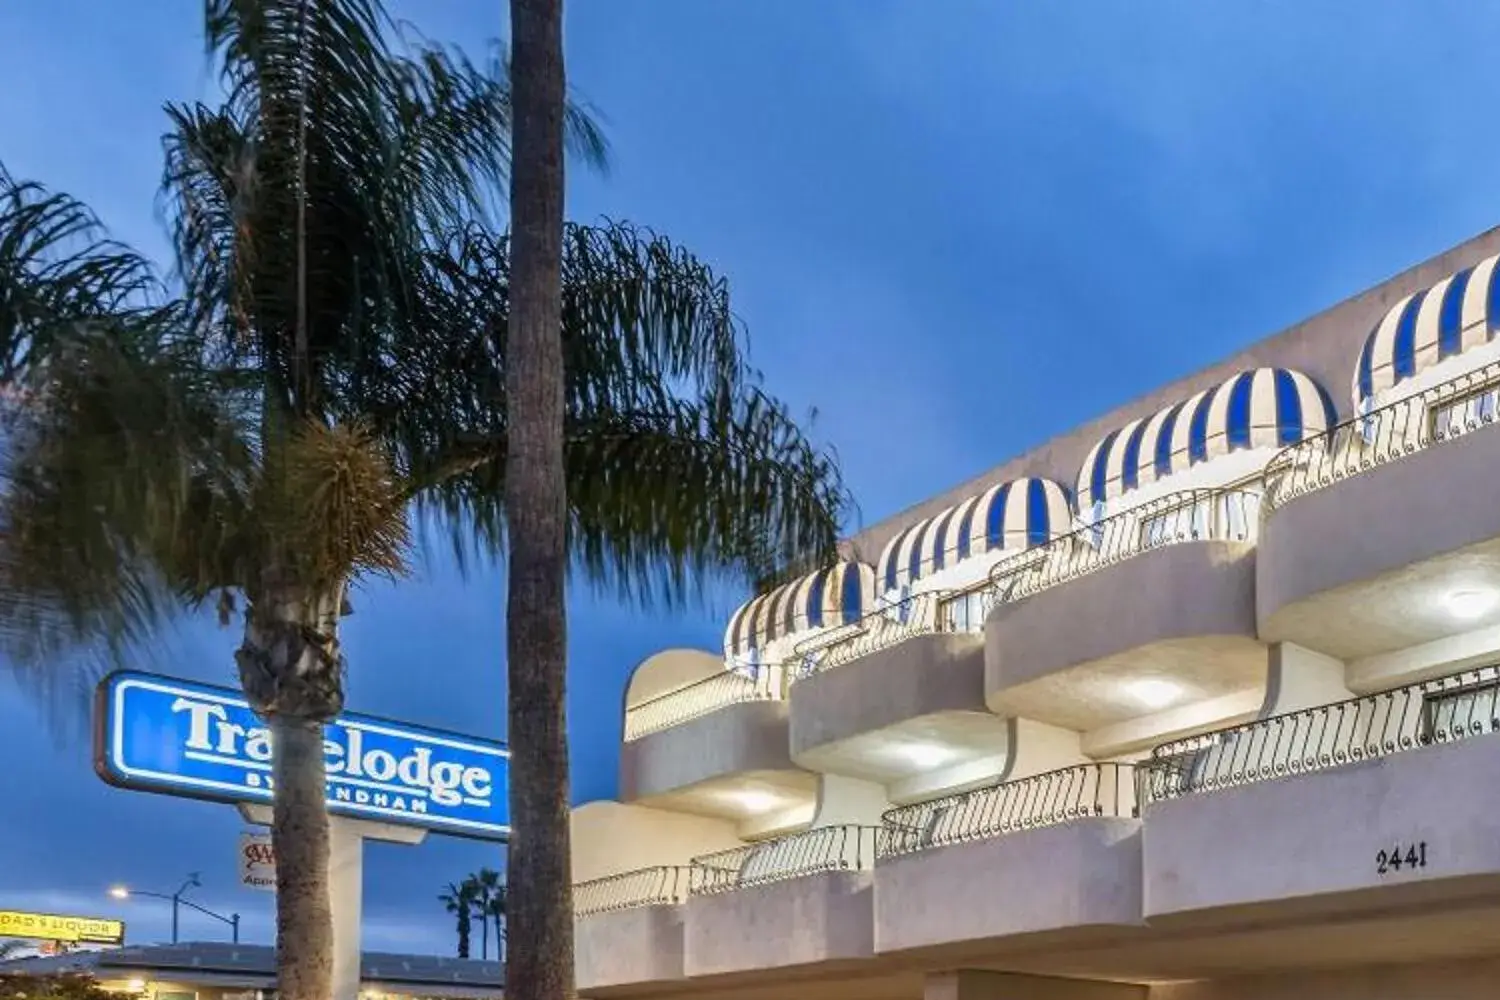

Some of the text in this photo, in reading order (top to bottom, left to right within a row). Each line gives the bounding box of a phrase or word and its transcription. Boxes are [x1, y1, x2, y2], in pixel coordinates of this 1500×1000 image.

[172, 697, 491, 807] Traelodge
[327, 783, 428, 814] NDHAM
[1376, 841, 1427, 874] 2441
